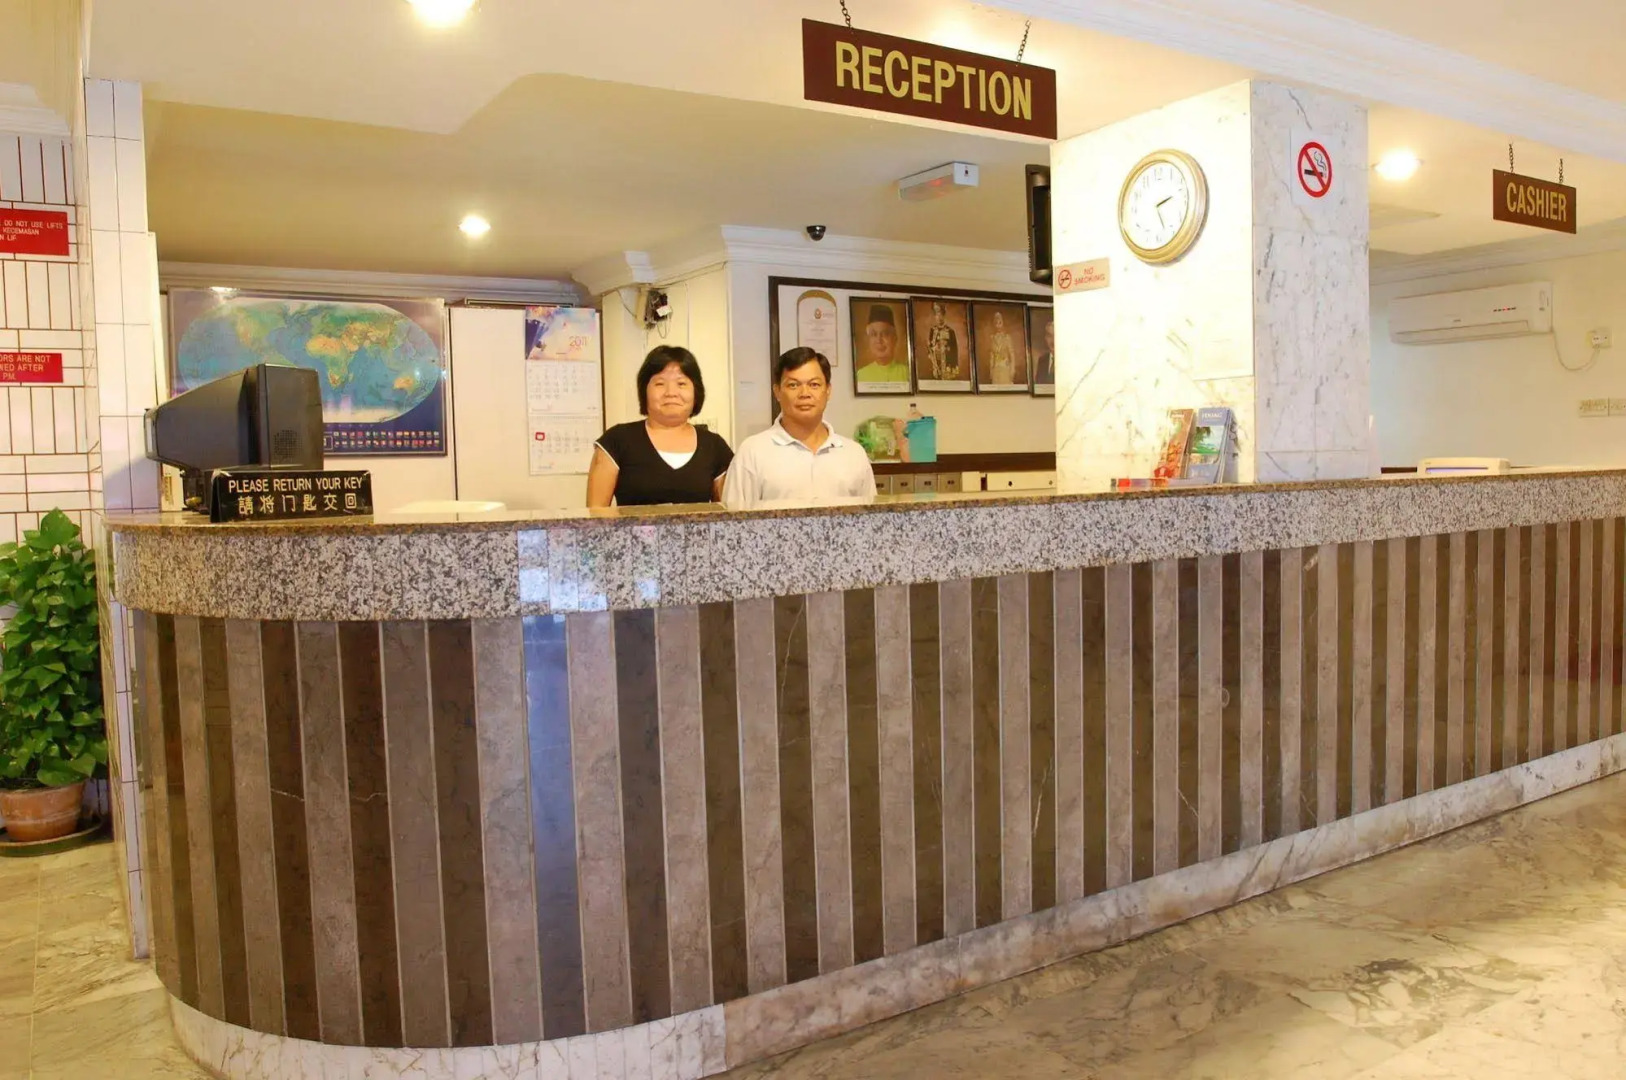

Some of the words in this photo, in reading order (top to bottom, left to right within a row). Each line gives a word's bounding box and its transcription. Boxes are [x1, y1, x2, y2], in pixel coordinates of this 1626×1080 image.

[835, 40, 1032, 121] RECEPTION
[1506, 181, 1567, 222] CASHIER
[15, 220, 28, 228] NOT
[31, 221, 44, 229] USE
[46, 222, 64, 230] LIFTS
[1083, 267, 1095, 275] NO
[1074, 274, 1106, 286] SMOKING
[16, 354, 32, 363] ARE
[34, 354, 51, 363] NOT
[17, 363, 44, 373] AFTER
[228, 479, 269, 493] PLEASE
[273, 478, 312, 491] RETURN
[316, 477, 341, 490] YOUR
[344, 477, 363, 489] KEY
